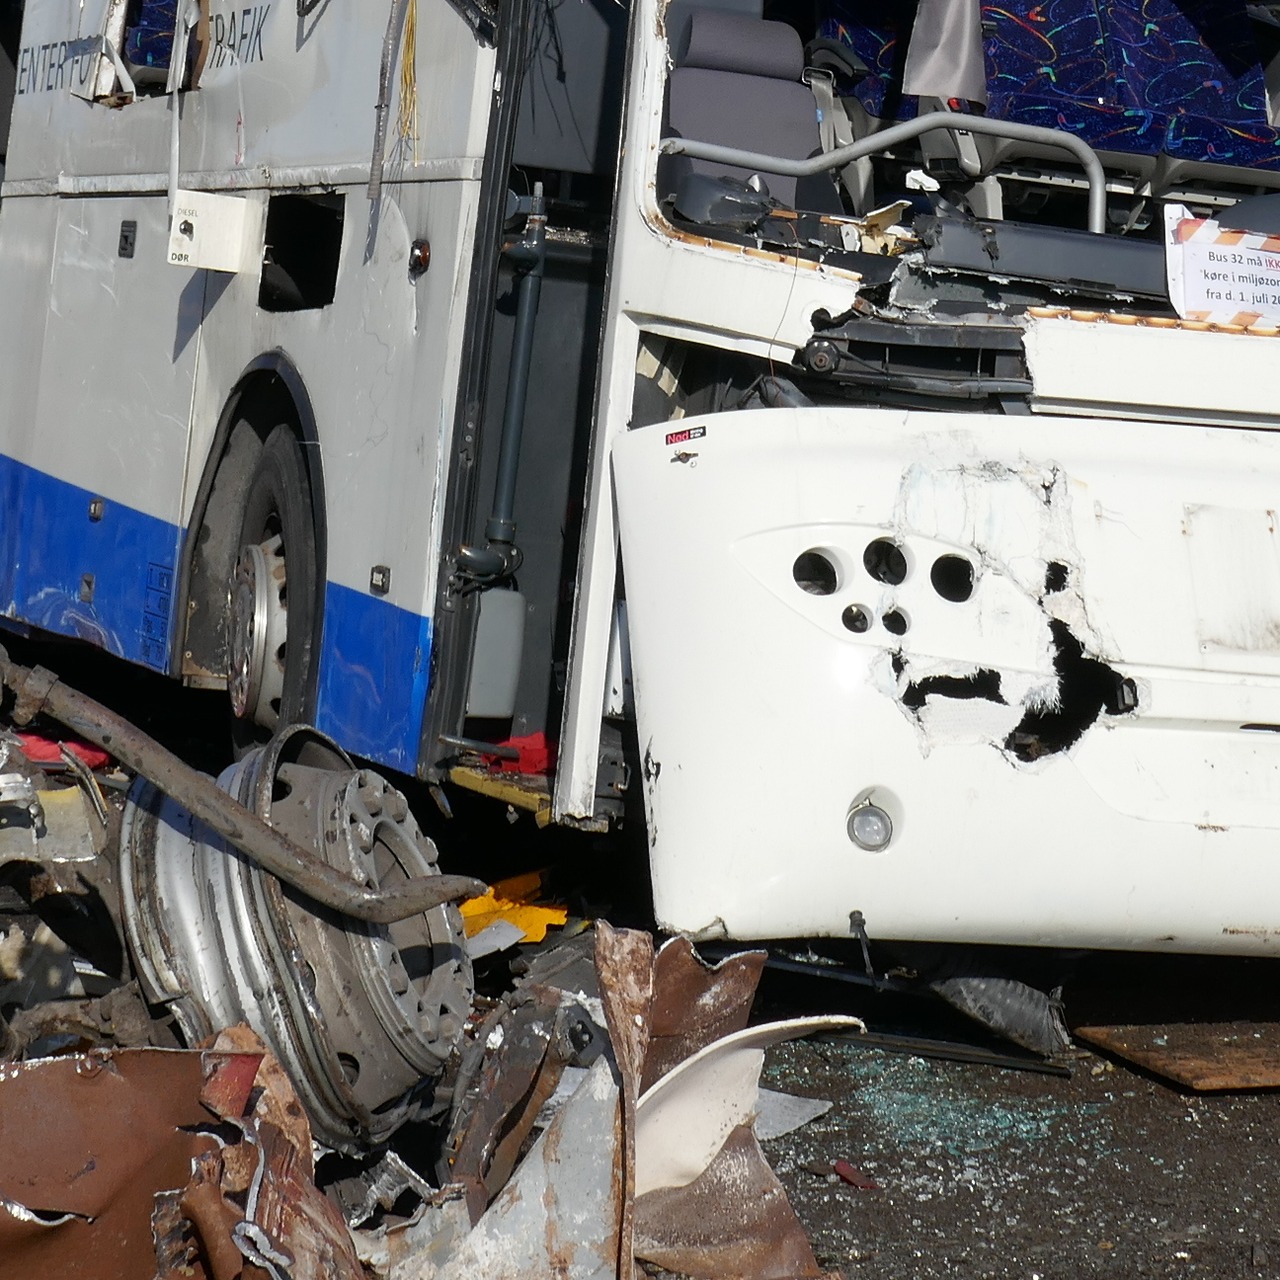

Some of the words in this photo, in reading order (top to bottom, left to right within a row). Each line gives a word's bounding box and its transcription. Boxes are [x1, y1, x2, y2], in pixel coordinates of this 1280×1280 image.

[208, 4, 271, 69] RAFIK
[177, 207, 199, 218] DIESEL
[171, 252, 189, 262] DØR
[1208, 251, 1228, 263] Bus
[1231, 253, 1244, 264] 32
[1246, 256, 1263, 267] må
[1203, 269, 1229, 282] køre
[1231, 271, 1236, 283] i
[1206, 288, 1222, 300] fra
[1225, 290, 1235, 301] d.
[1239, 291, 1249, 302] 1.
[1252, 292, 1269, 305] juli
